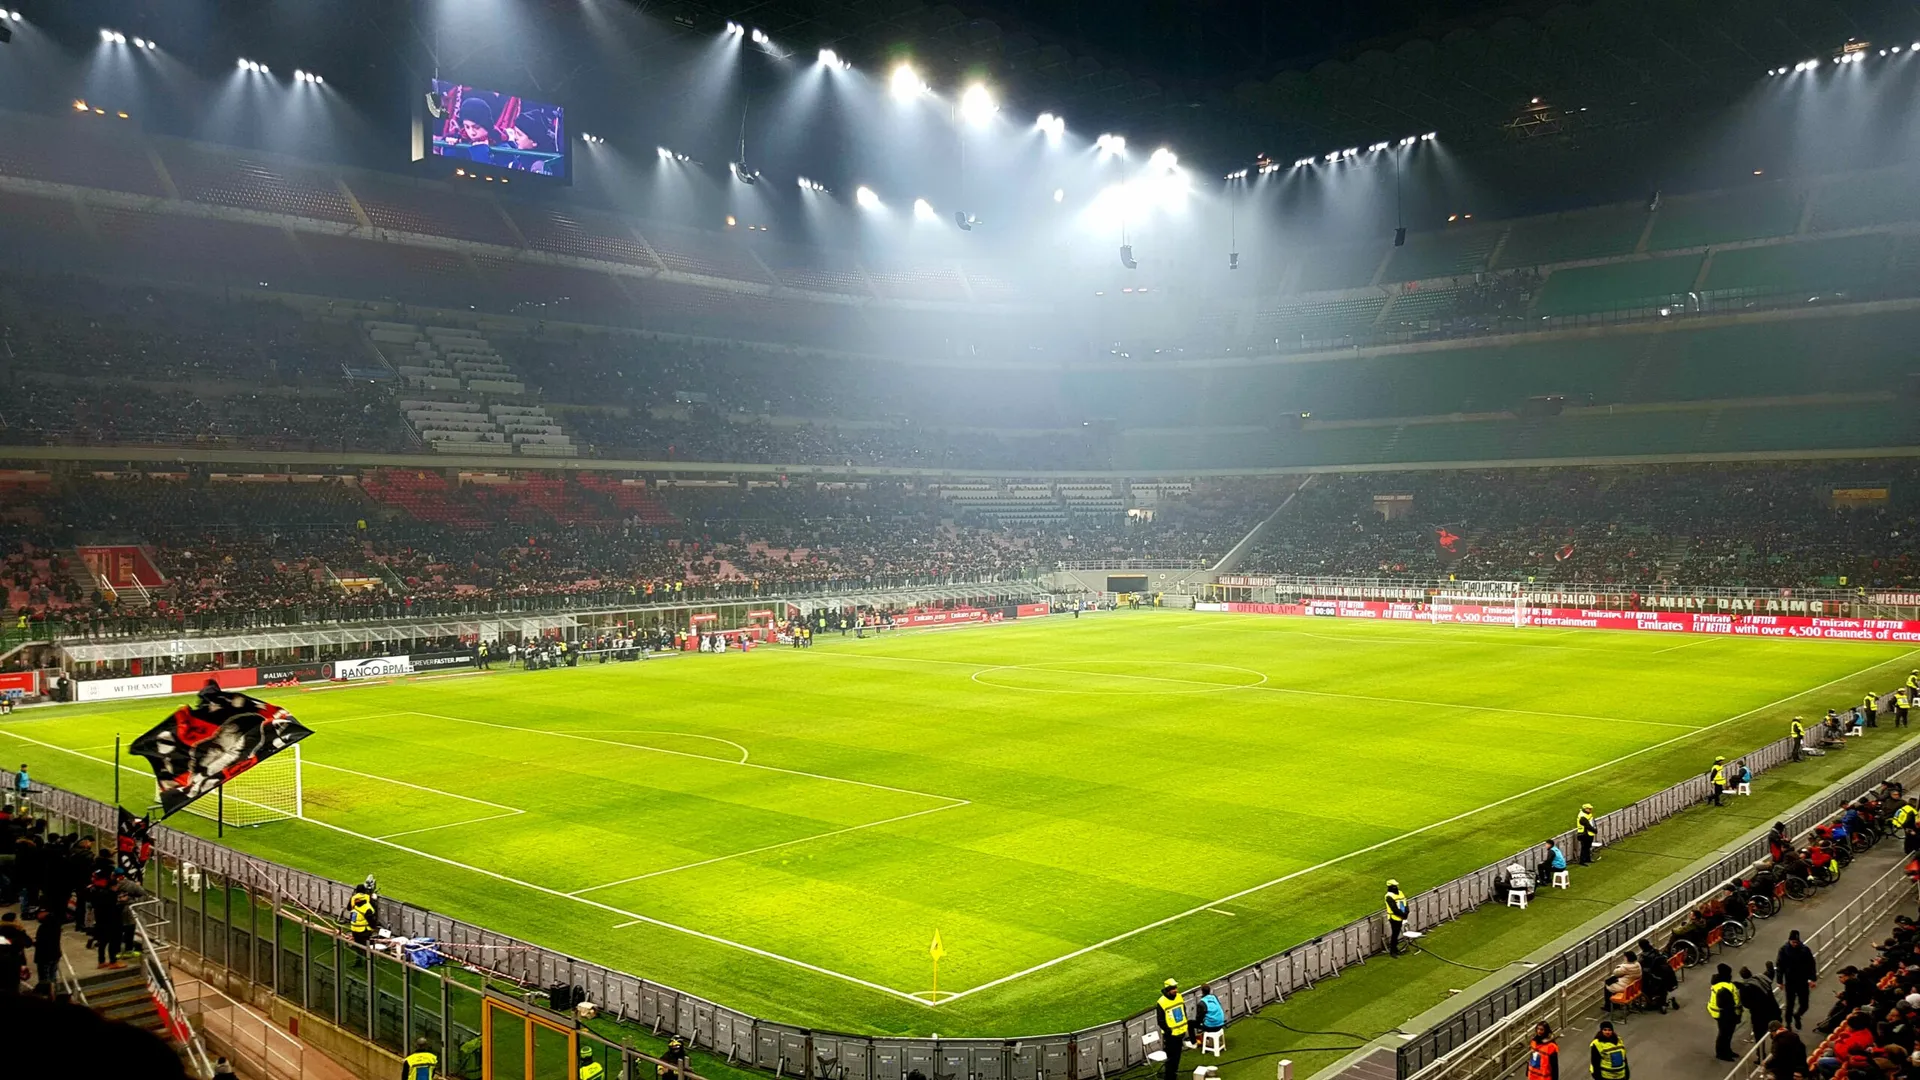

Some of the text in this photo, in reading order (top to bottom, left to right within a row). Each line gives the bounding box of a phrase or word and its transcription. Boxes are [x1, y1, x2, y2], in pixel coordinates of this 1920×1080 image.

[1482, 582, 1518, 594] MICHELE
[1522, 593, 1558, 604] SCUOLA
[1562, 593, 1596, 605] CALCIO
[1640, 596, 1706, 608] FAMILY
[1717, 598, 1756, 610] DAY
[1237, 604, 1297, 615] OFFICIAL APP
[1315, 607, 1335, 616] 00:00
[1341, 608, 1376, 617] Emirates
[1455, 612, 1480, 623] 4,500
[1521, 615, 1532, 624] of
[1534, 616, 1596, 627] entertainment
[1638, 619, 1684, 630] Emirates
[1693, 622, 1705, 632] FLY
[1706, 622, 1732, 633] BETTER
[1734, 625, 1758, 634] with
[1762, 627, 1785, 635] over
[1789, 626, 1821, 638] 4,500
[1824, 628, 1872, 639] channels
[1876, 629, 1889, 639] of
[341, 664, 404, 678] BANCO BPM
